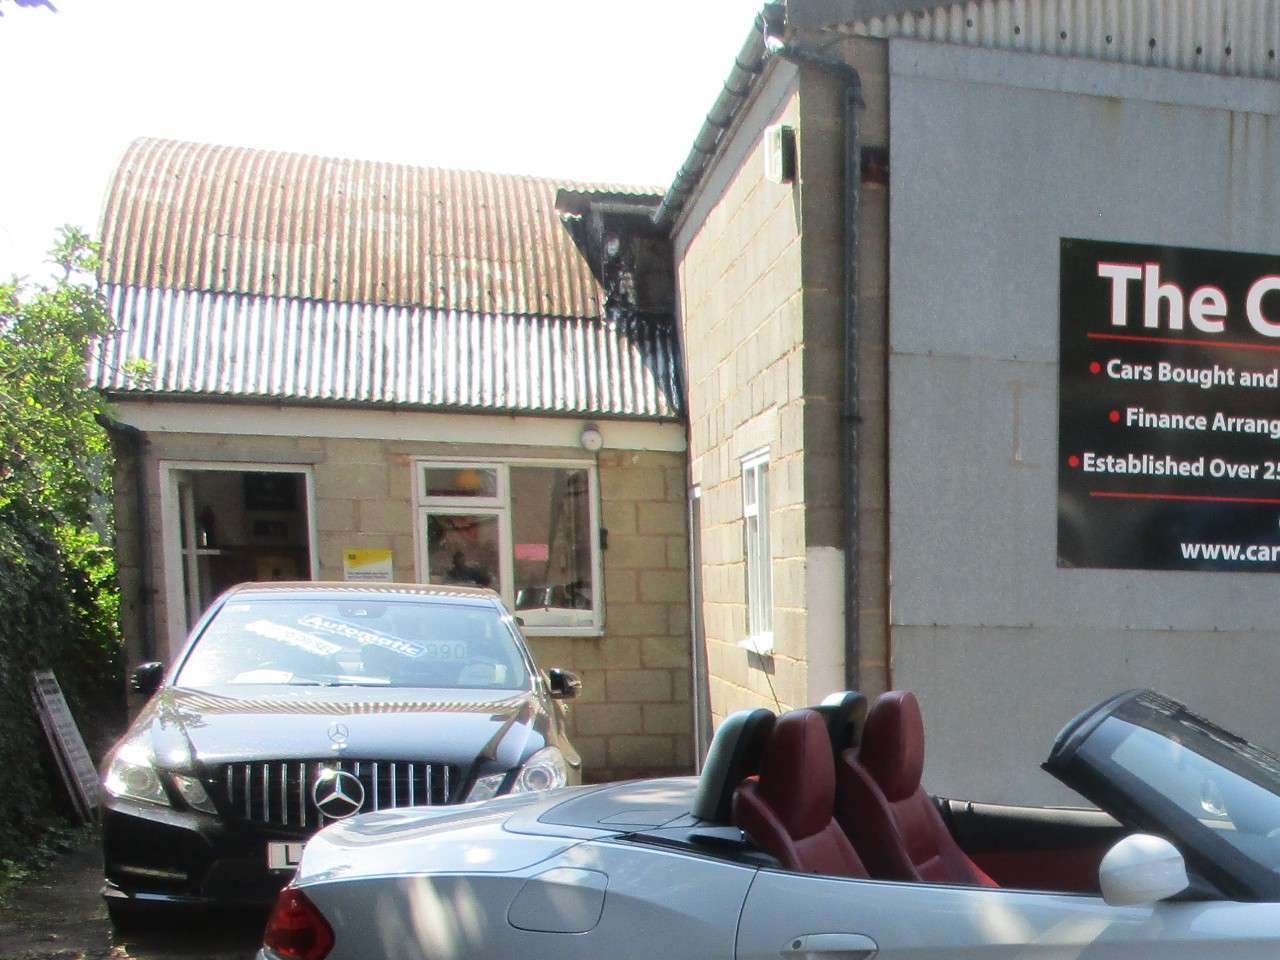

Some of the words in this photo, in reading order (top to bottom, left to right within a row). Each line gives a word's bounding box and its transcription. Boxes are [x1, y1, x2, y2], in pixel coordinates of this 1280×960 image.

[1098, 264, 1227, 333] The
[1107, 359, 1152, 380] Cars
[1159, 362, 1235, 389] Bought
[1240, 368, 1278, 388] and
[1127, 408, 1207, 430] Finance
[1084, 453, 1204, 476] Established
[1210, 459, 1258, 478] Over
[303, 615, 420, 657] Automatic
